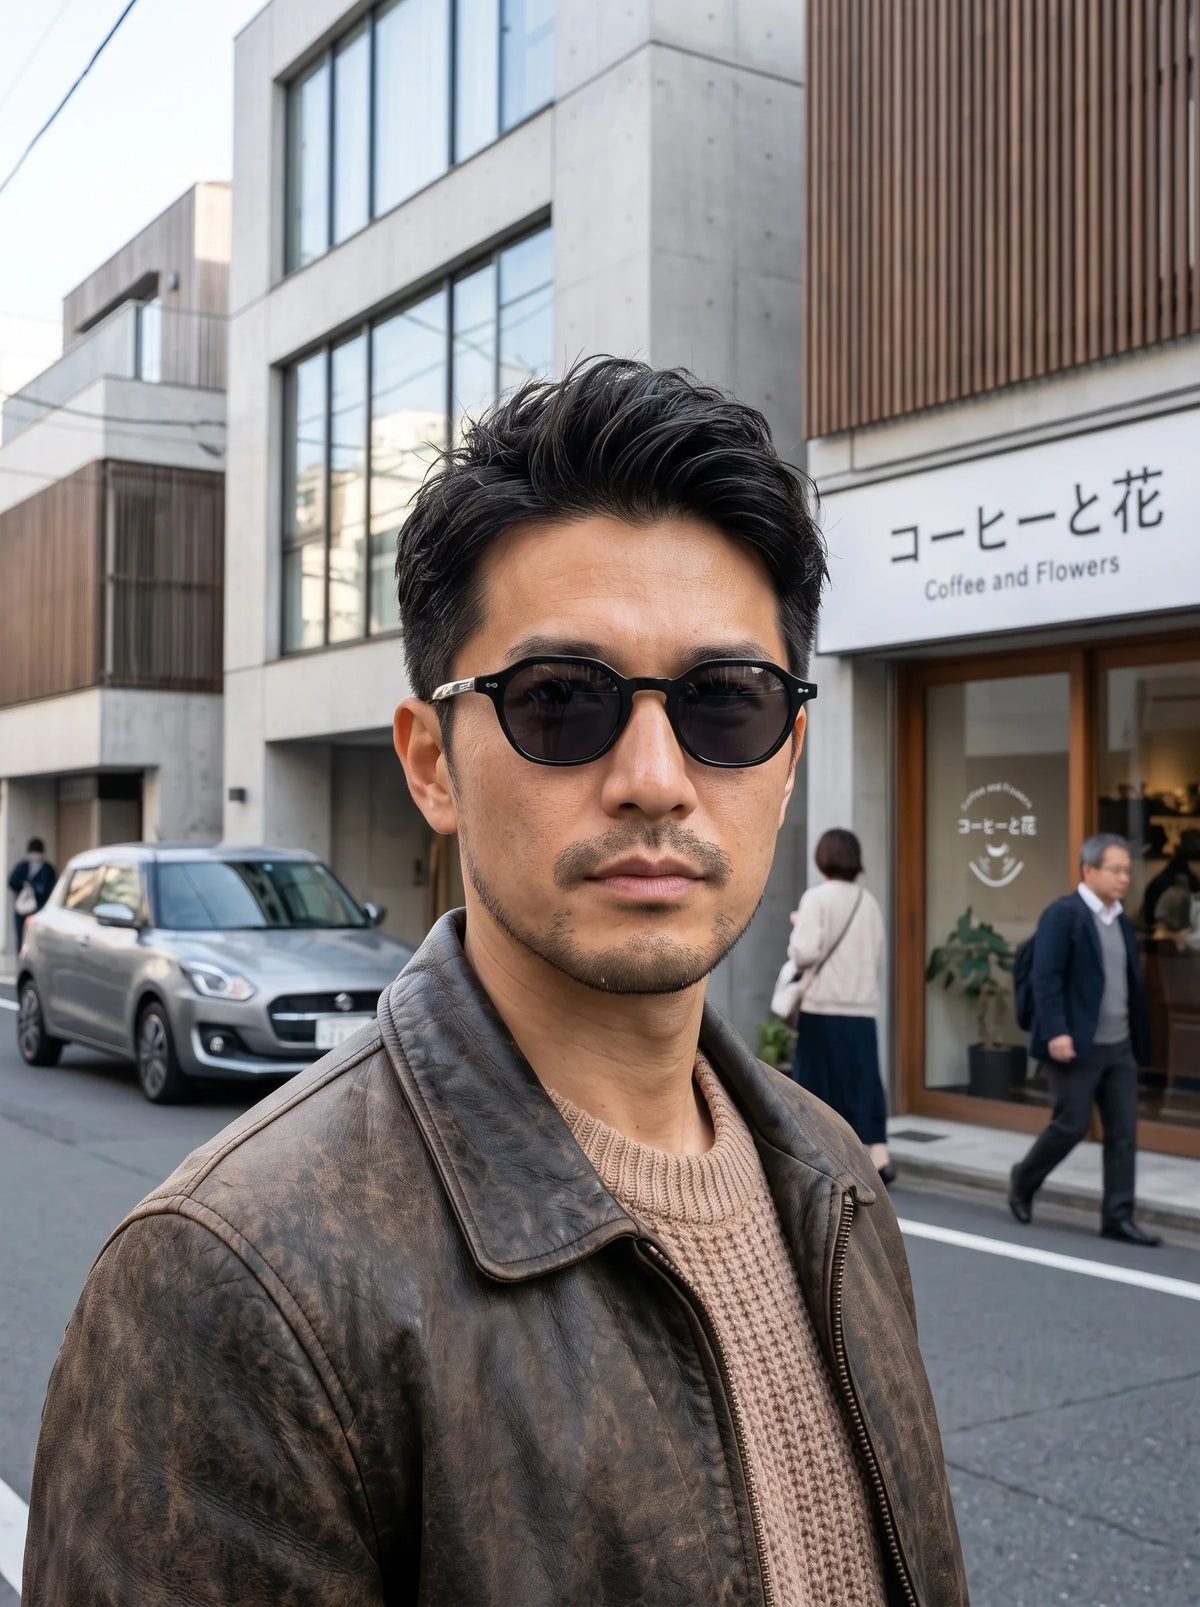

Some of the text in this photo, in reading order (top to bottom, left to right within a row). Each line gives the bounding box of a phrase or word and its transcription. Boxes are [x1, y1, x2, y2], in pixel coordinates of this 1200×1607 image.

[891, 466, 1164, 563] コーヒーと花
[925, 555, 1120, 601] Coffee and Flowers
